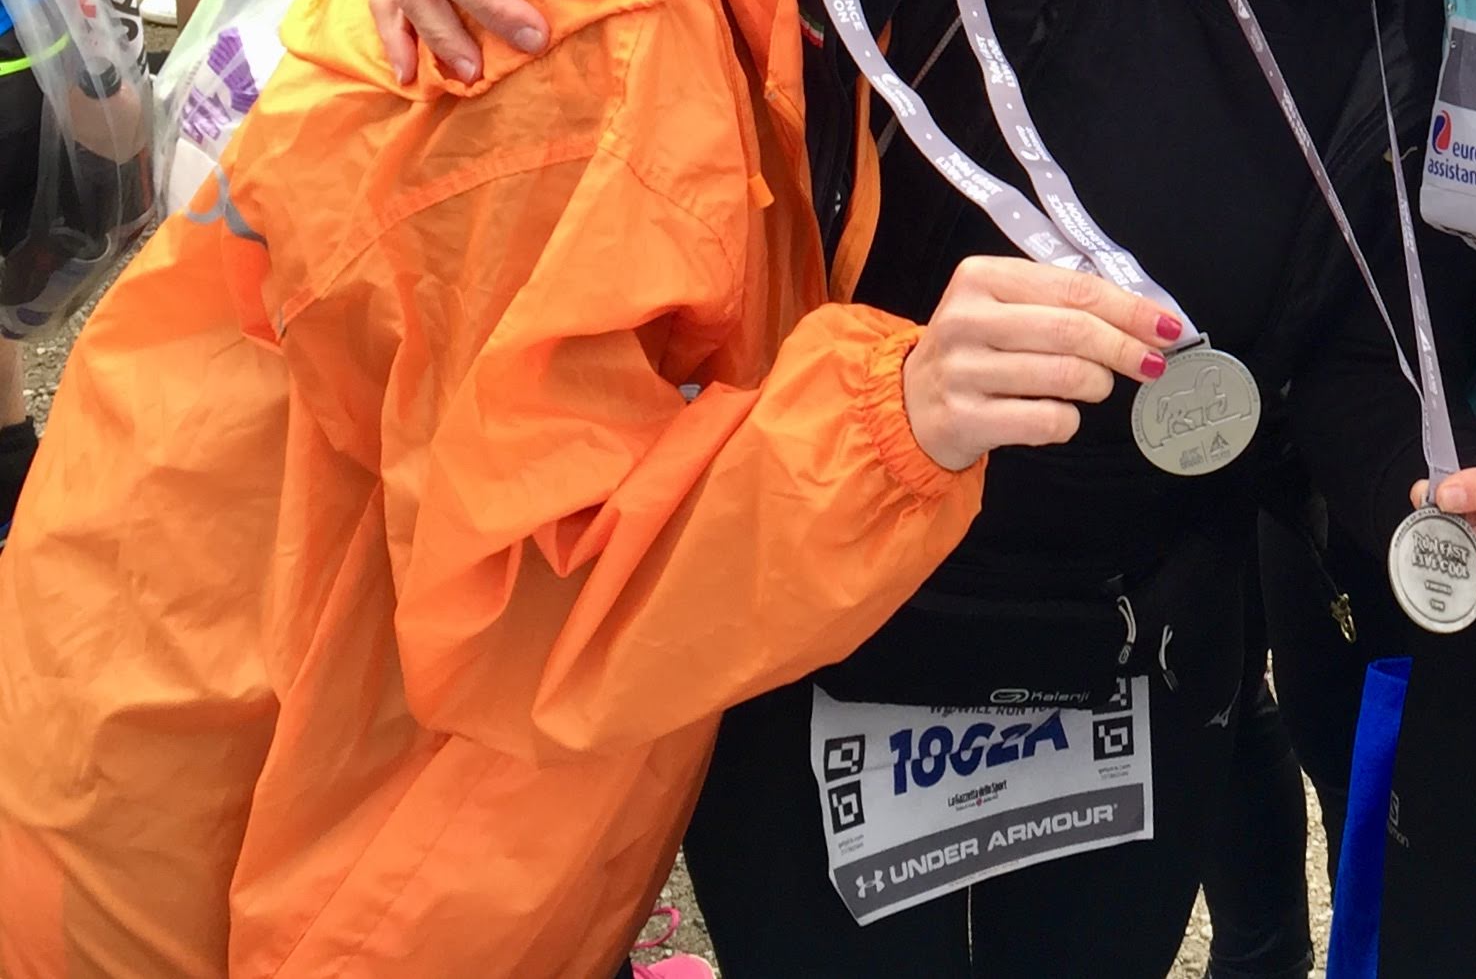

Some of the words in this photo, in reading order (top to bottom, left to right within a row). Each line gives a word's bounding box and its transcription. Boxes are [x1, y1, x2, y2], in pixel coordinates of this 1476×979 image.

[1412, 530, 1440, 555] RUN
[1439, 540, 1470, 566] FAST
[1412, 550, 1440, 571] LIVE
[1440, 560, 1470, 580] COOL
[889, 838, 980, 884] UNDER
[987, 804, 1114, 852] ARMOUR
